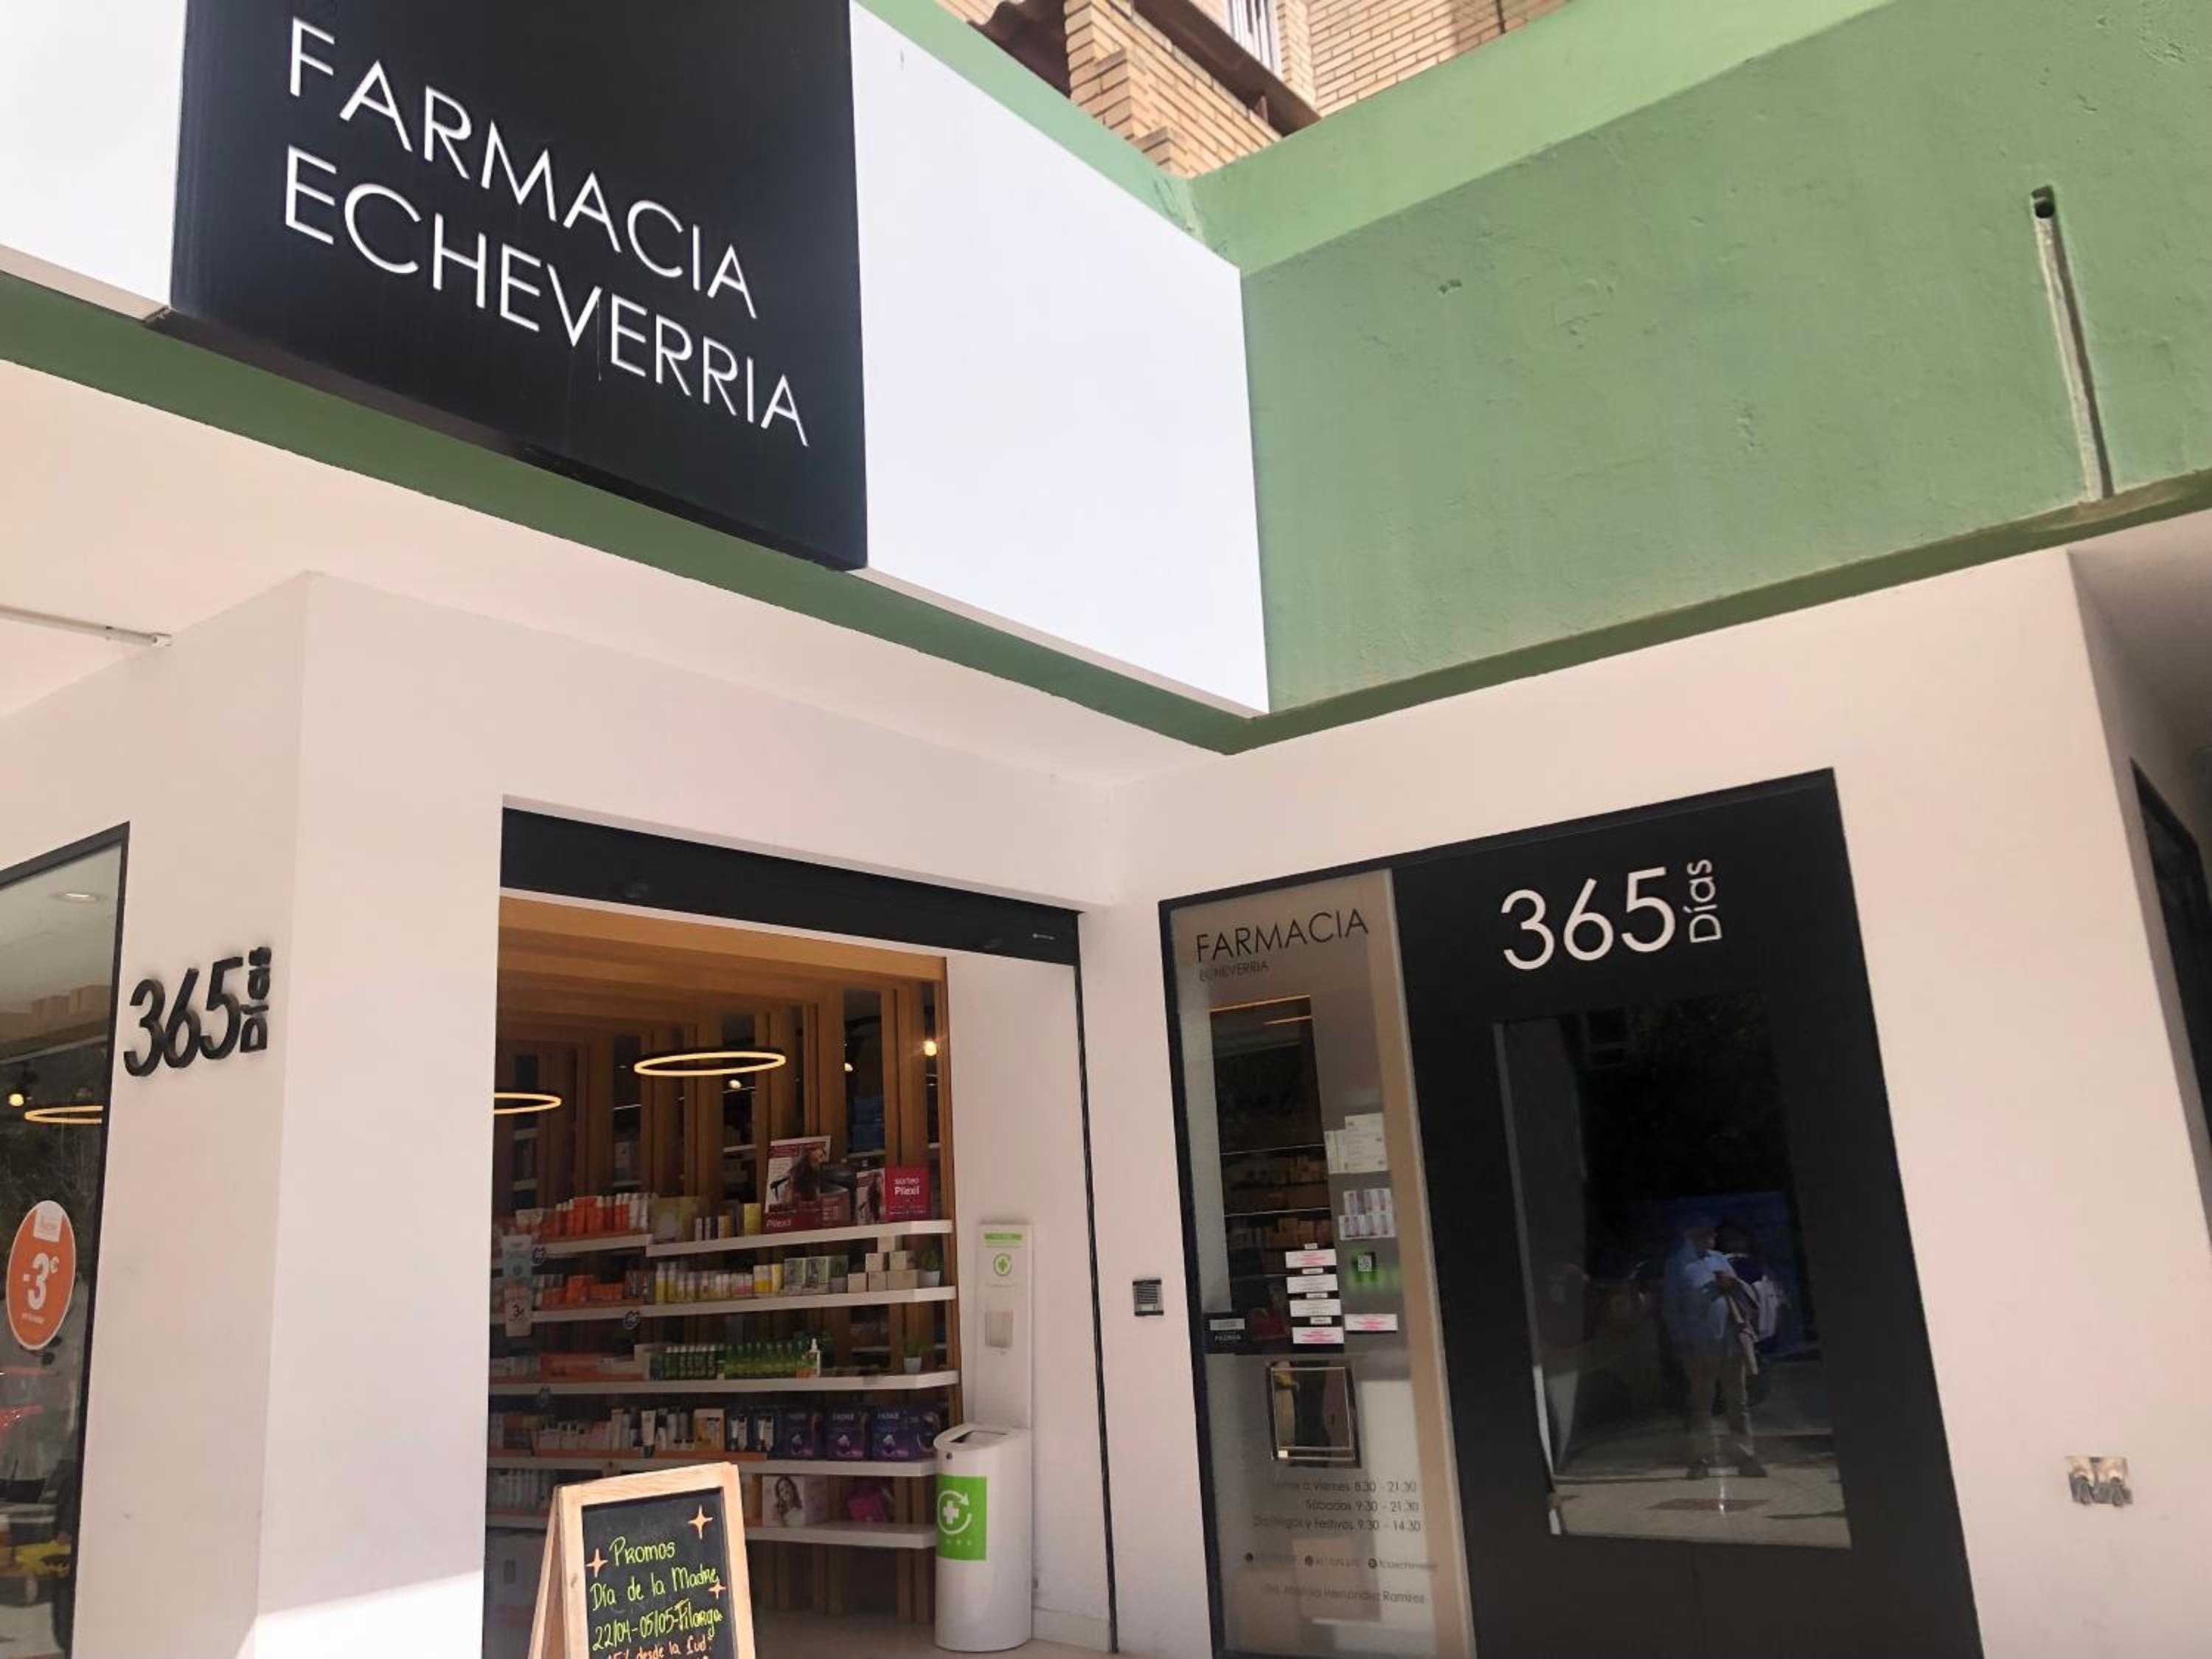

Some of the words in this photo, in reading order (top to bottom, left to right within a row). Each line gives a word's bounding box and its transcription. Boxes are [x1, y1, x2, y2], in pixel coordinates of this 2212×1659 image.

[290, 16, 758, 320] FARMACIA
[285, 145, 810, 448] ECHEVERRIA
[1197, 908, 1369, 962] FARMACIA
[1500, 866, 1676, 970] 365
[1683, 859, 1722, 944] Días
[124, 956, 244, 1077] 365
[627, 1575, 644, 1601] de
[650, 1571, 666, 1596] la
[669, 1640, 682, 1656] la
